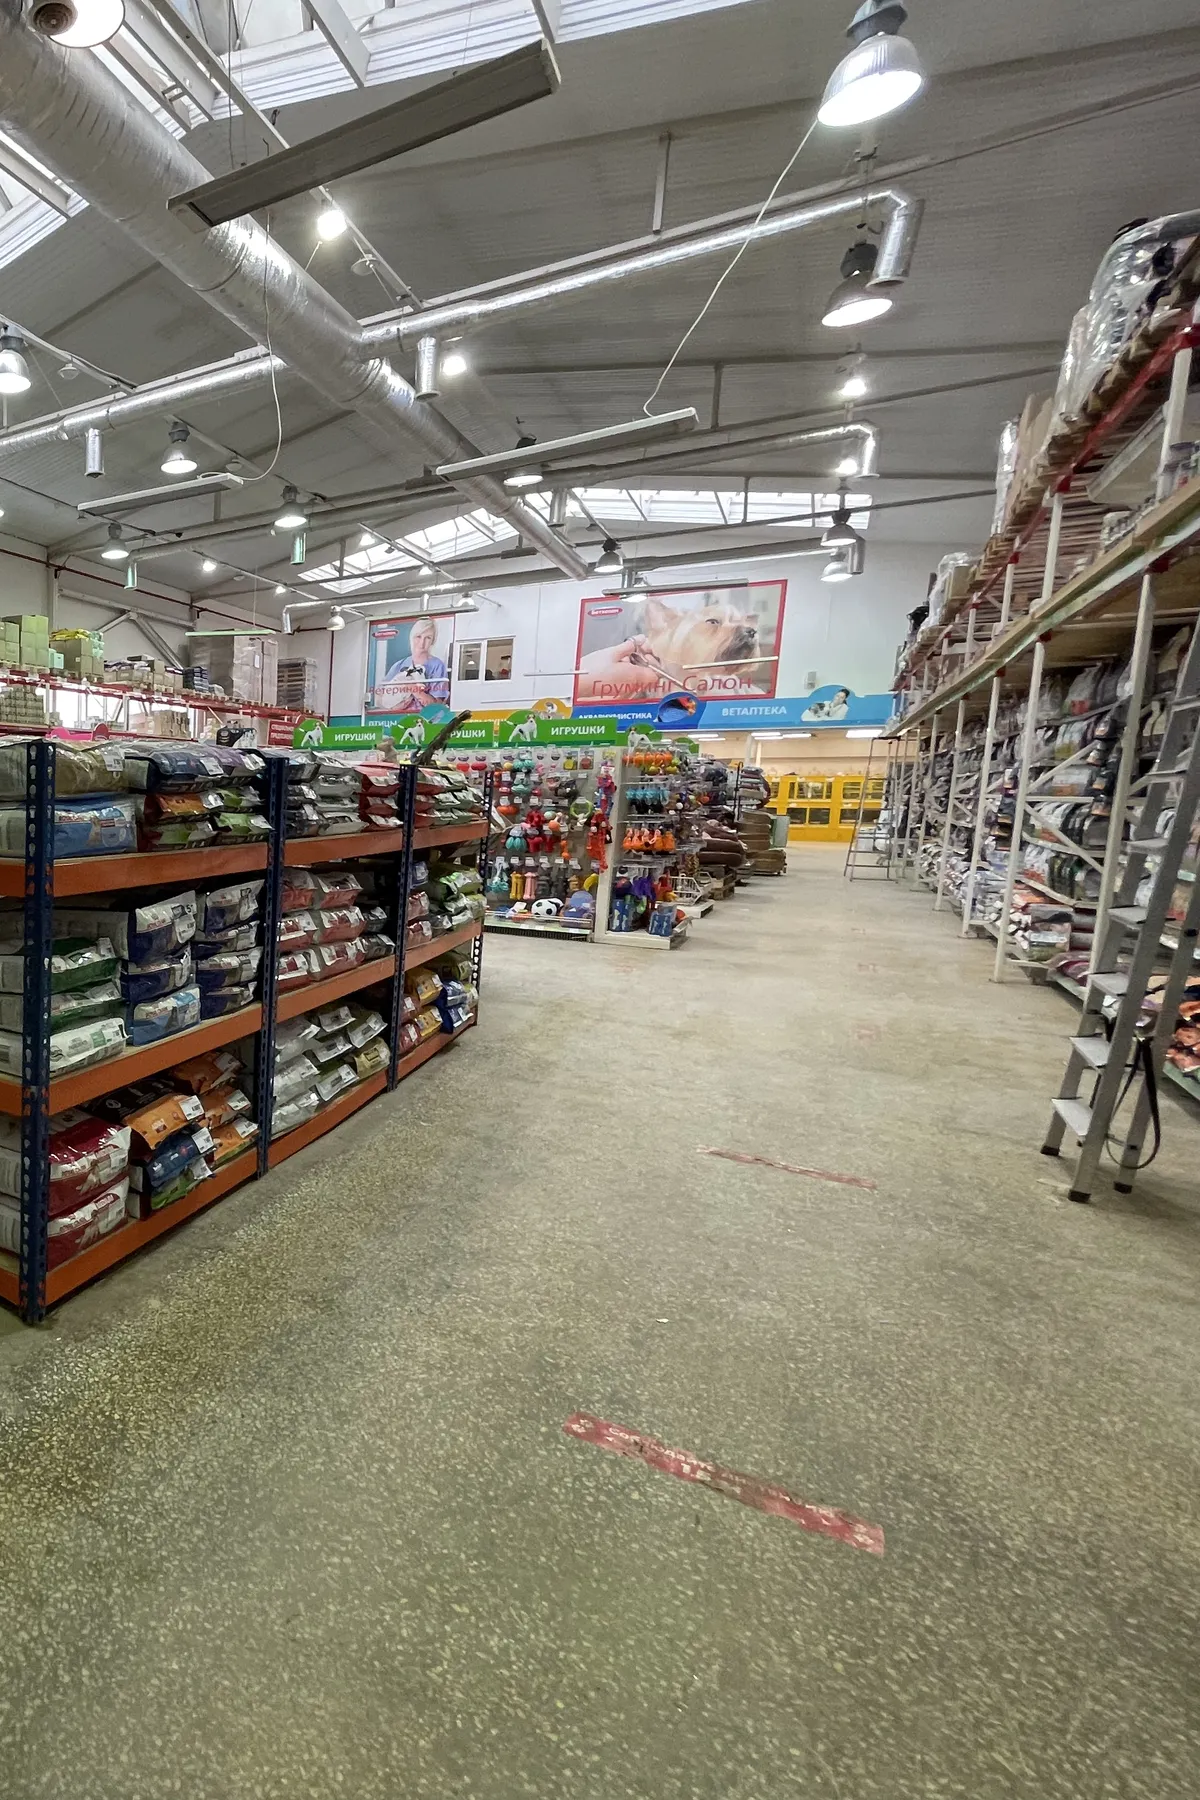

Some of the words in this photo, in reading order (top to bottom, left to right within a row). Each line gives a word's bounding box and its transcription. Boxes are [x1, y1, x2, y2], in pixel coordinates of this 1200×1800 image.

[682, 674, 752, 692] Салон
[721, 705, 787, 717] ВЕТАПТЕКА
[450, 729, 486, 738] РУШКИ
[551, 725, 606, 736] ИГРУШКИ
[334, 733, 376, 742] ИГРУШКИ
